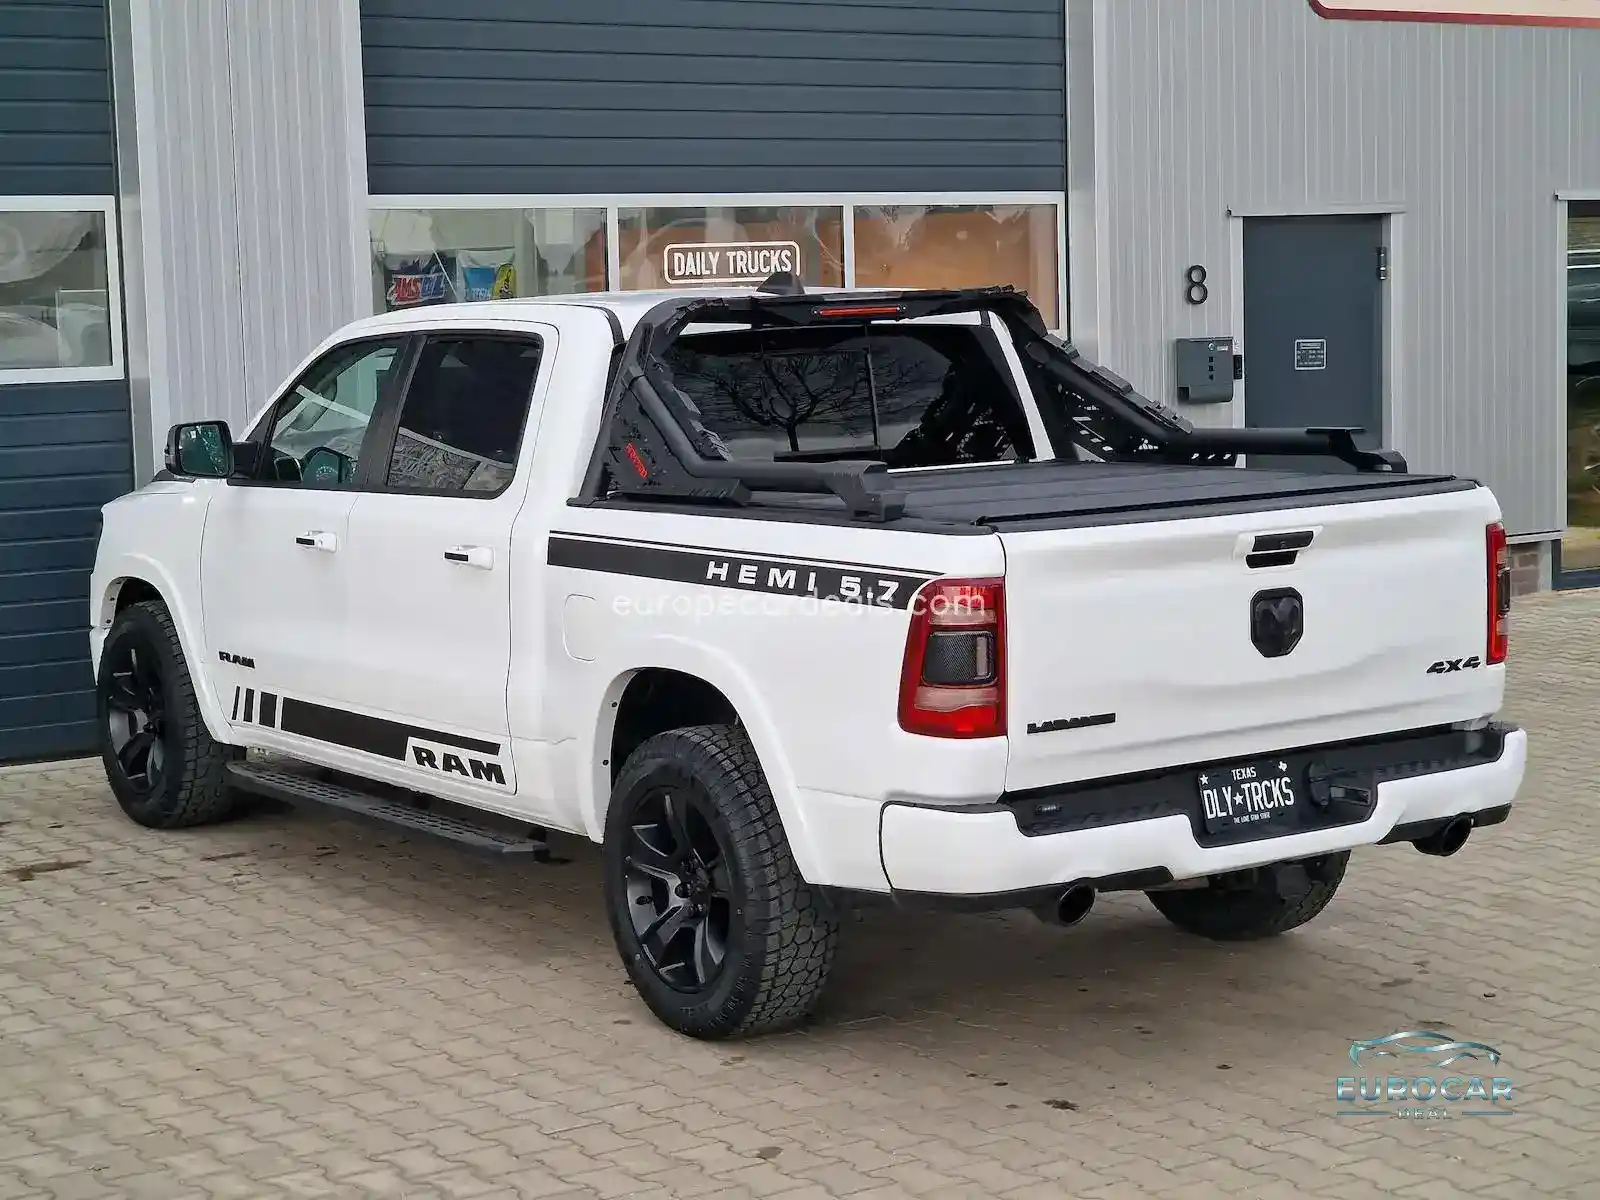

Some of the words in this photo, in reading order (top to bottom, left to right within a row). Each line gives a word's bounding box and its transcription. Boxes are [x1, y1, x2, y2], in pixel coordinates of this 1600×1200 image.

[673, 251, 720, 276] DAILY
[726, 249, 792, 274] TRUCKS
[1187, 265, 1208, 305] 8
[706, 560, 816, 591] HEMI
[839, 576, 900, 601] 5.7
[411, 746, 507, 785] RAM
[1231, 767, 1257, 780] TEXAS
